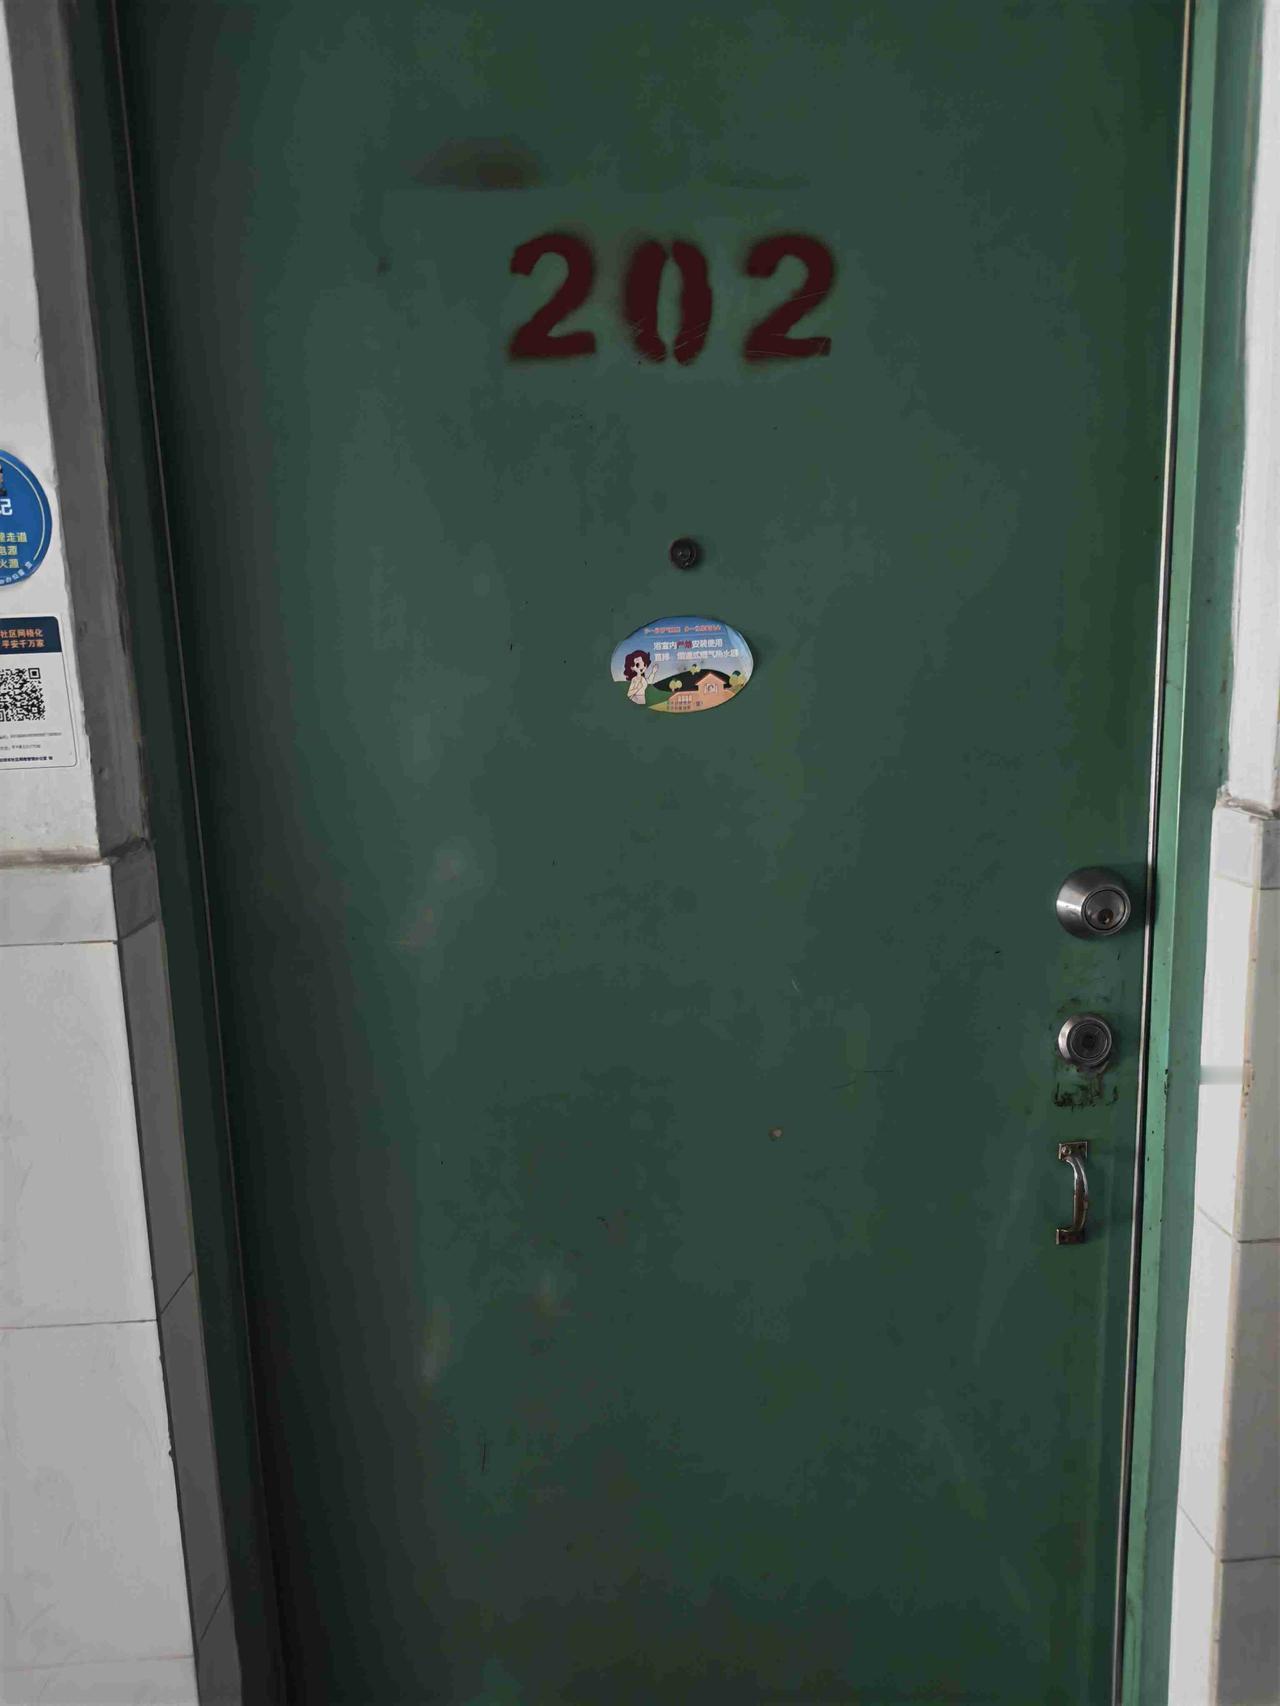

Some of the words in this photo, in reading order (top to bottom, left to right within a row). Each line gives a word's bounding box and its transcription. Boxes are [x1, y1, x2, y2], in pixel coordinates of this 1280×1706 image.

[509, 231, 834, 364] 202
[2, 639, 45, 649] 平安千万家
